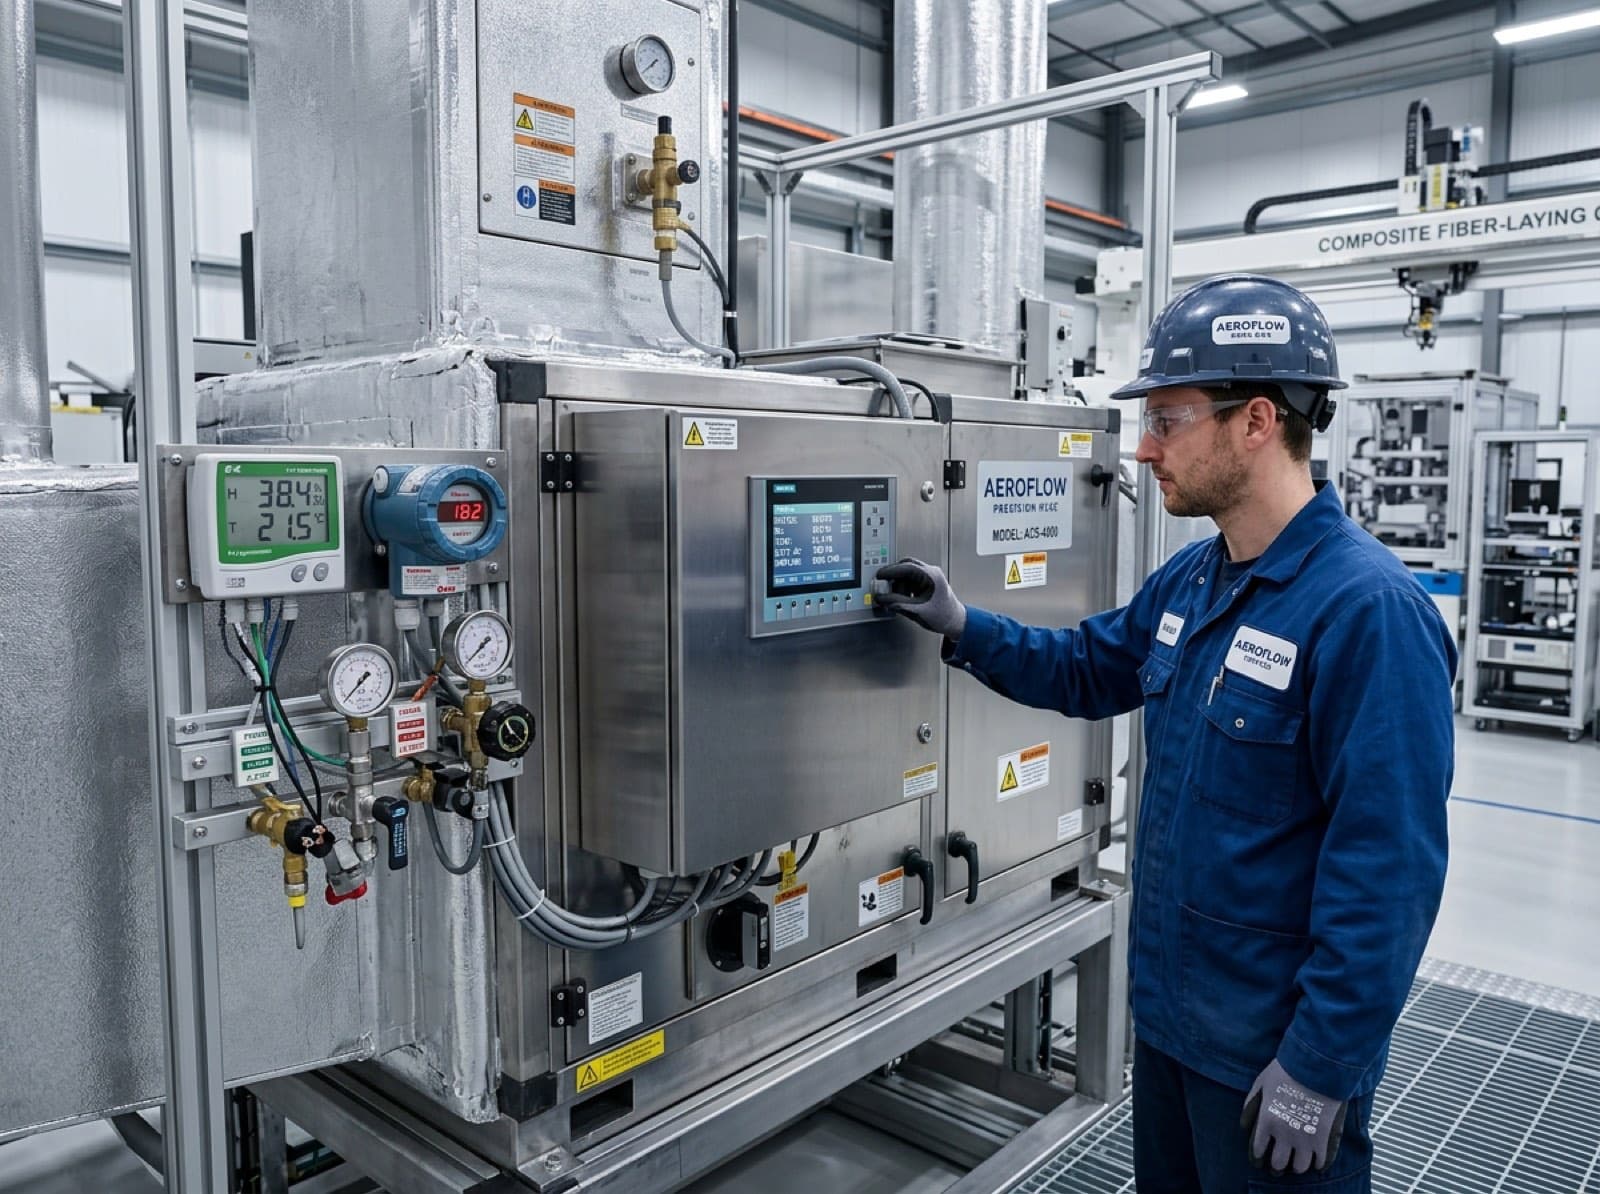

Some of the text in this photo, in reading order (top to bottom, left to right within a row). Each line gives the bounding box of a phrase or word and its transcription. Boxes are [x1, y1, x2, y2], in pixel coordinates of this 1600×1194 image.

[1318, 225, 1430, 253] COMPOSITE
[1438, 207, 1586, 240] FIBER-LAYING
[1216, 320, 1285, 332] AEROFLOW
[227, 488, 237, 500] H
[258, 480, 312, 508] 38.4
[983, 477, 1067, 498] AEROFLOW
[455, 503, 482, 520] 182
[228, 521, 237, 534] T
[258, 512, 312, 542] 21.5
[1234, 639, 1292, 667] AEROFLOW
